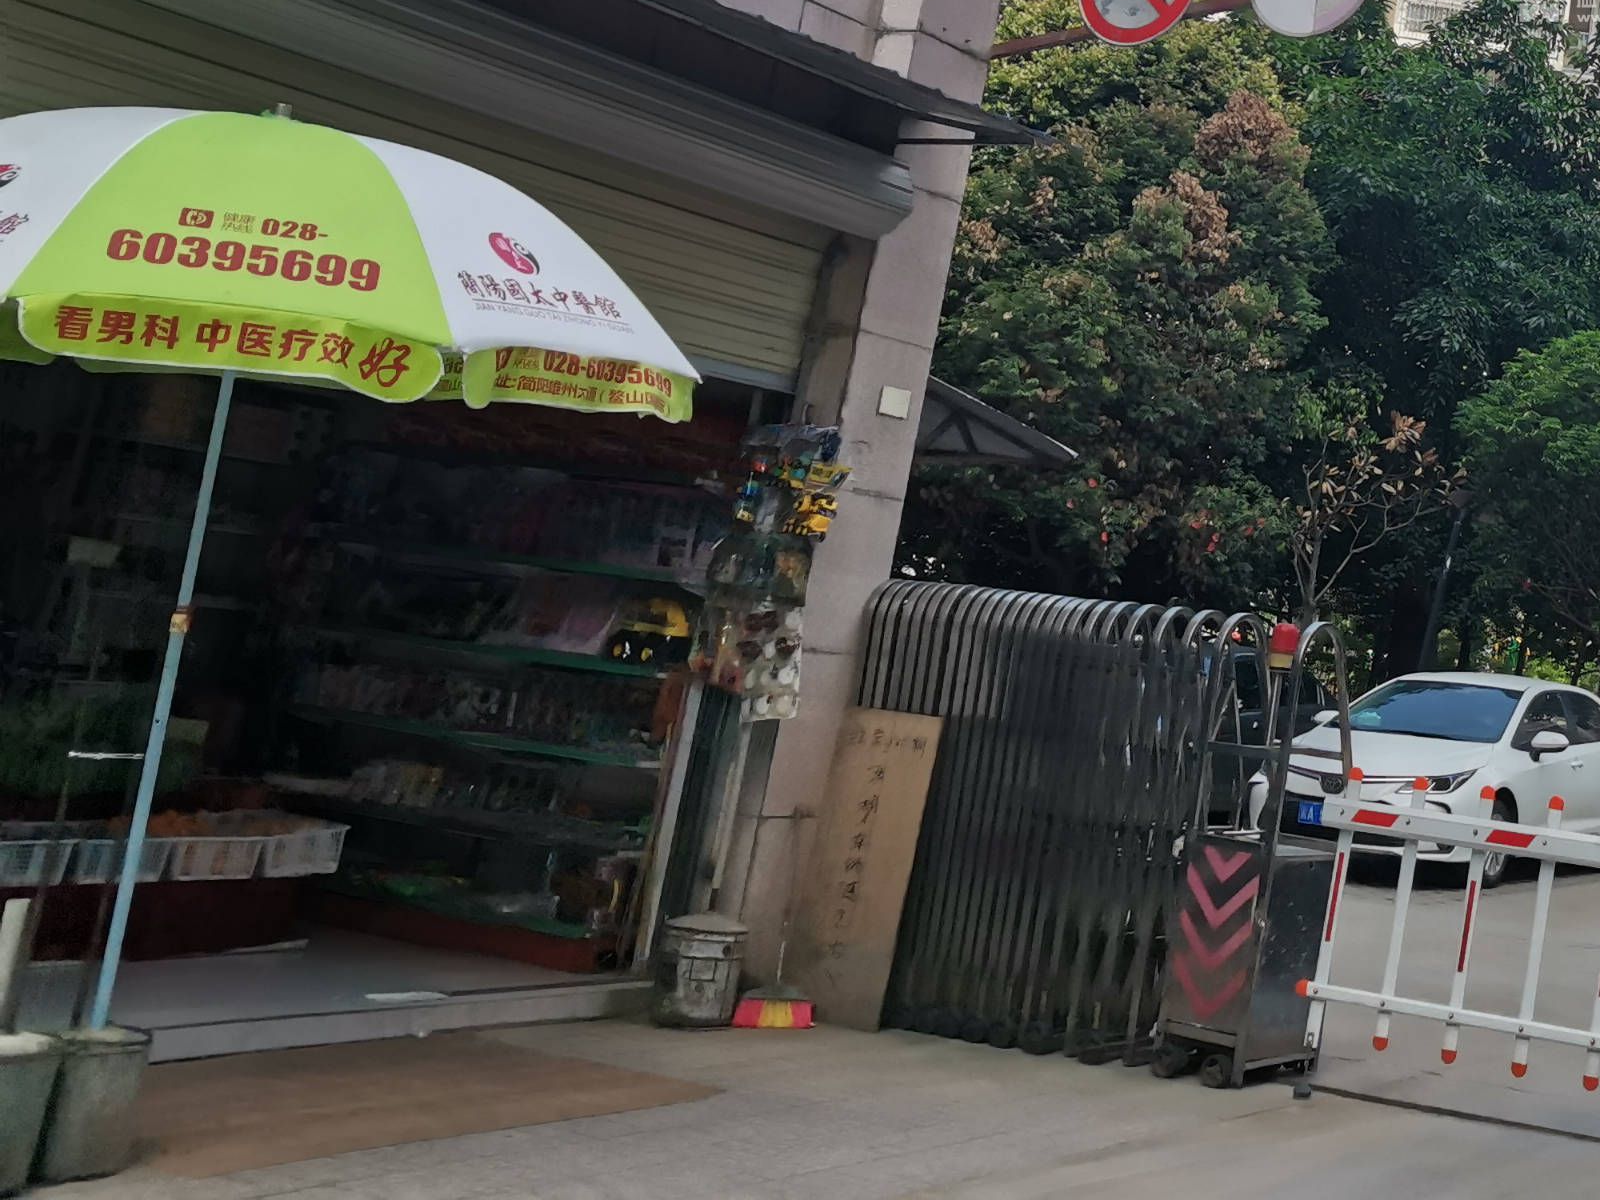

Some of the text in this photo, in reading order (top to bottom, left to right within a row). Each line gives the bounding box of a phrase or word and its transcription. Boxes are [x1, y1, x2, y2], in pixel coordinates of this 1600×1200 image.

[106, 228, 381, 292] 60395699
[260, 218, 328, 241] 028-
[54, 304, 412, 388] 看男科 中医疗效好
